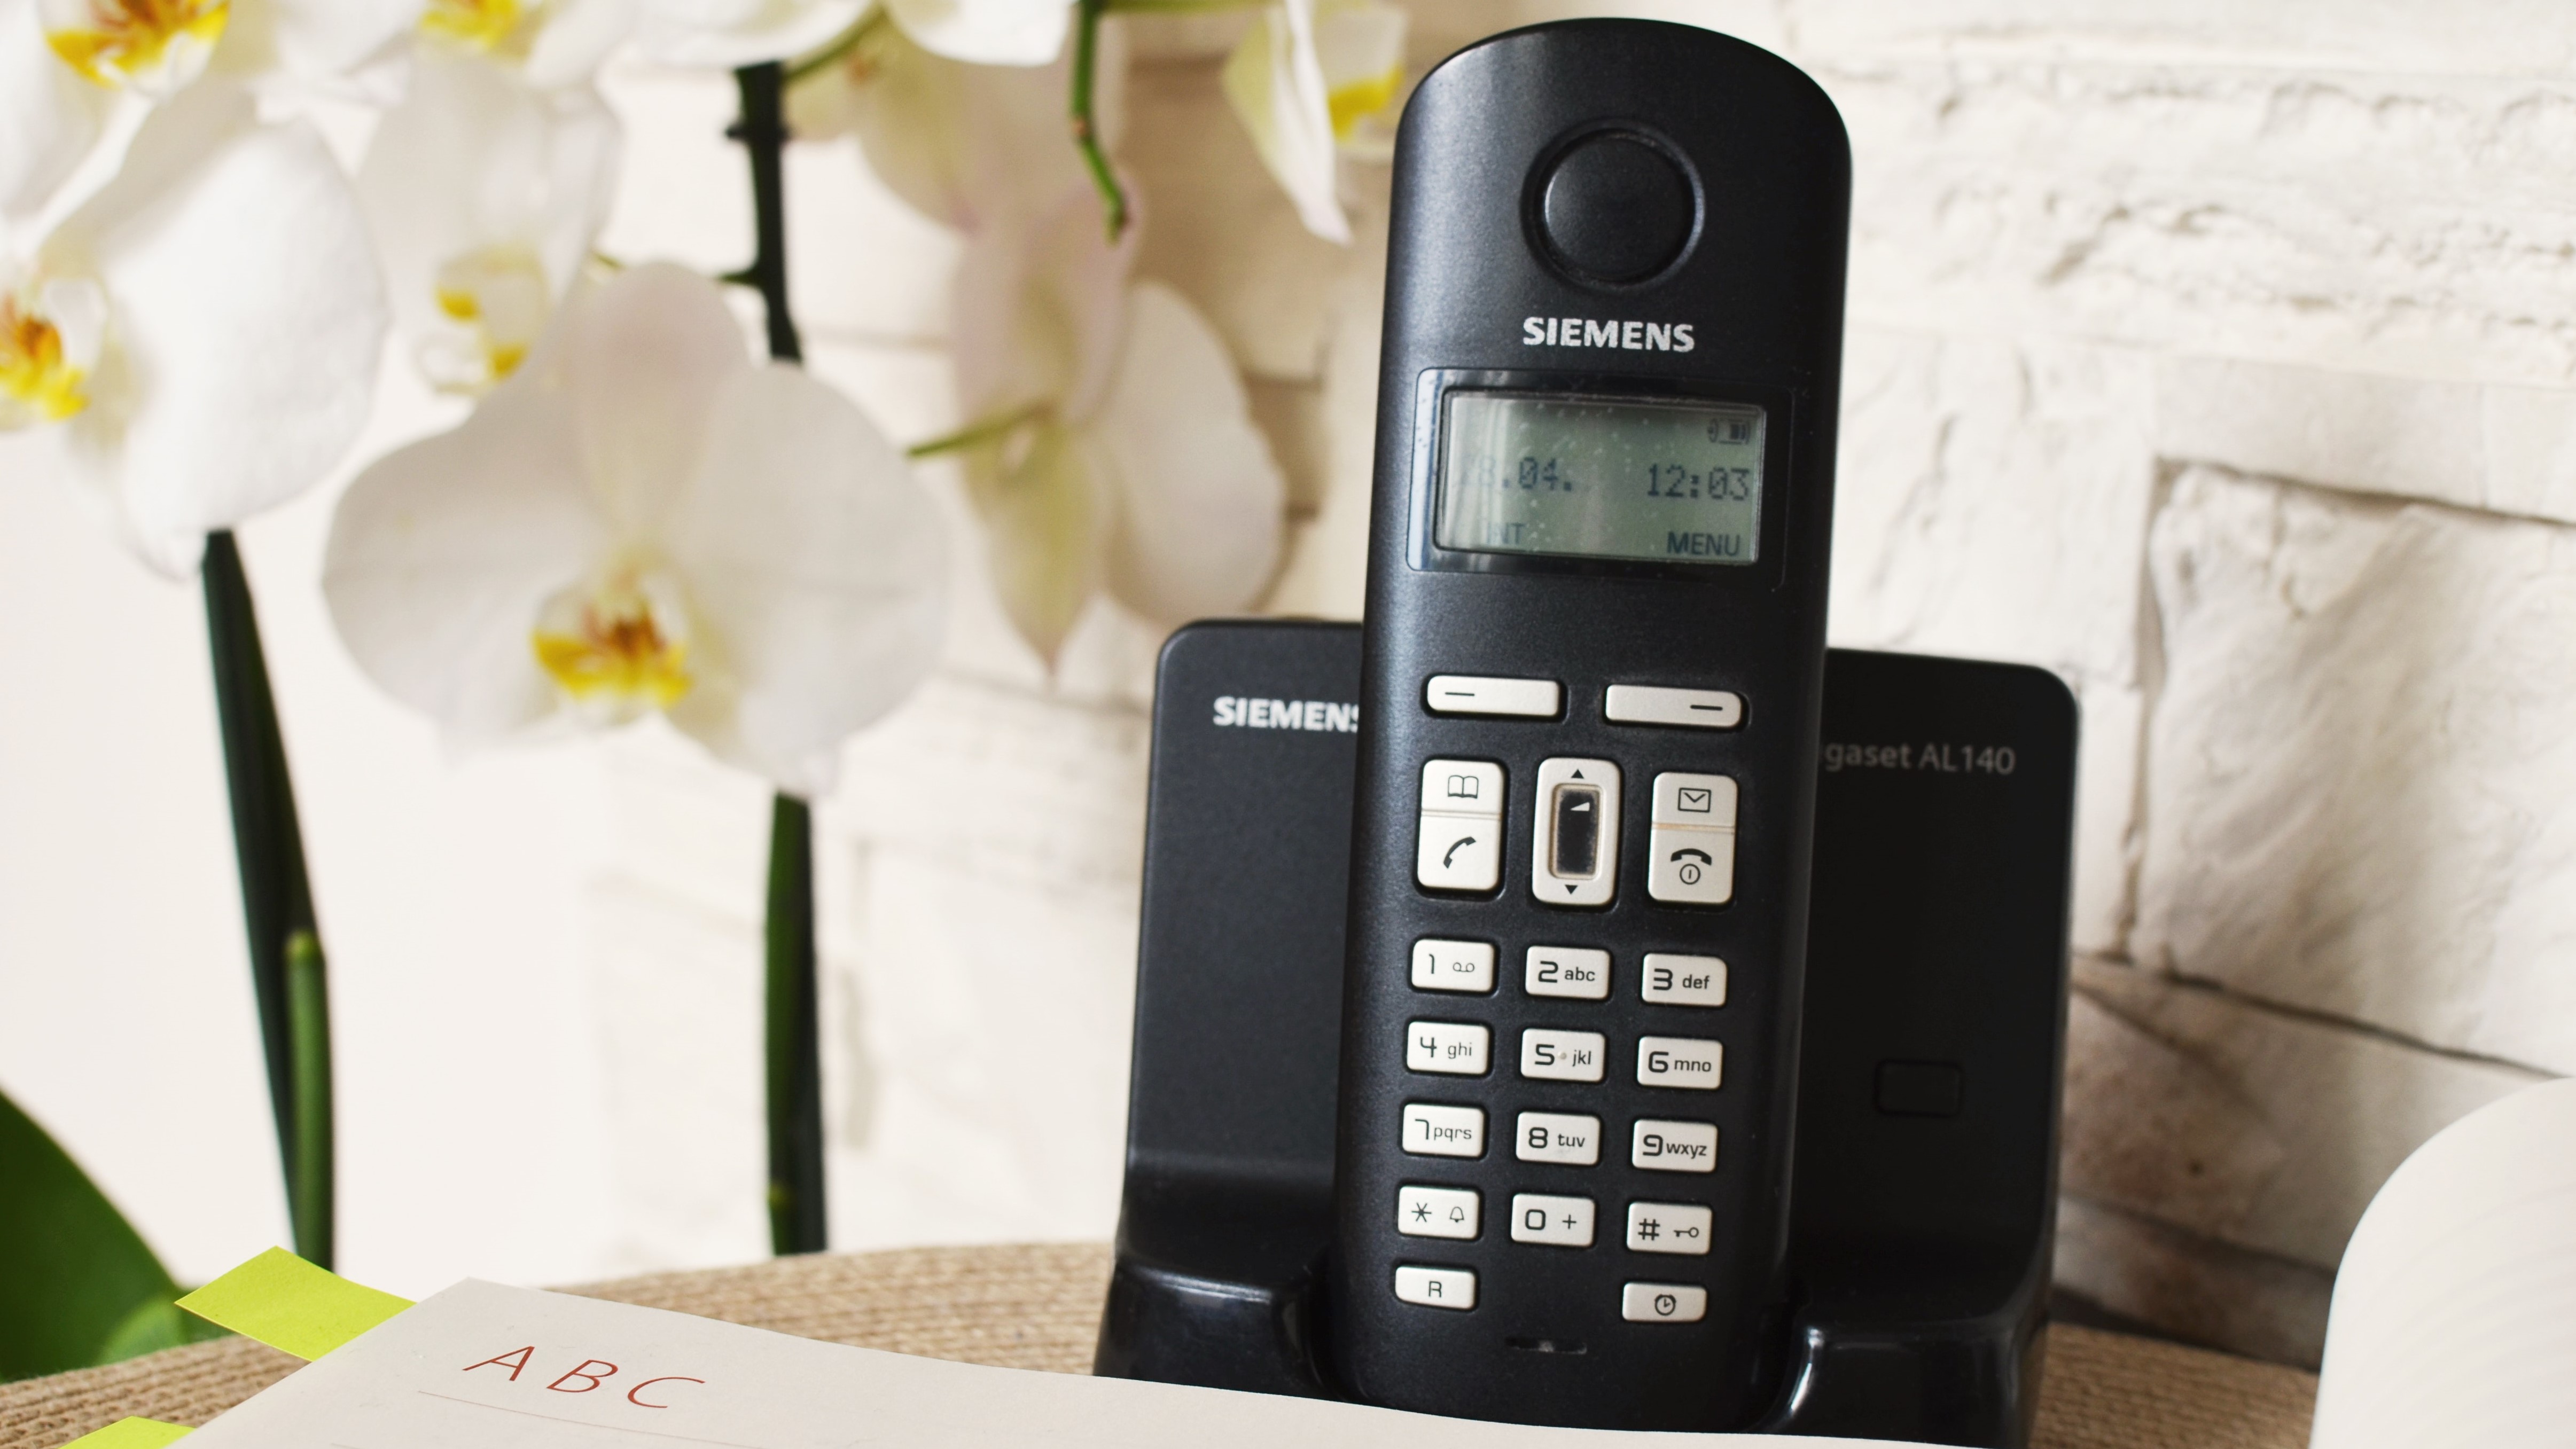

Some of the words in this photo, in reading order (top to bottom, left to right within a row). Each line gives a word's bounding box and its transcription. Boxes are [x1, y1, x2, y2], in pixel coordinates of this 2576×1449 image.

[1523, 316, 1695, 353] SIEMENS
[1647, 464, 1750, 501] 12:03
[1667, 531, 1740, 557] MENU
[1818, 742, 1911, 772] gaset
[1918, 742, 2016, 775] AL140
[1428, 953, 1435, 975] 1
[1537, 960, 1559, 983] 2
[1564, 966, 1596, 982] abc
[1652, 967, 1674, 991] 3
[1682, 974, 1710, 990] def
[1419, 1036, 1438, 1059] 4
[1447, 1041, 1472, 1060] ghi
[1534, 1043, 1556, 1066] 5
[1572, 1049, 1592, 1067] jkl
[1648, 1050, 1669, 1074] 6
[1674, 1059, 1712, 1073] mno
[1414, 1118, 1430, 1140] 7
[1433, 1127, 1472, 1142] pqrs
[1528, 1126, 1549, 1149] 8
[1557, 1133, 1586, 1148] tuv
[1642, 1133, 1664, 1157] 9
[1666, 1142, 1707, 1160] wxyz
[1428, 1280, 1442, 1298] R
